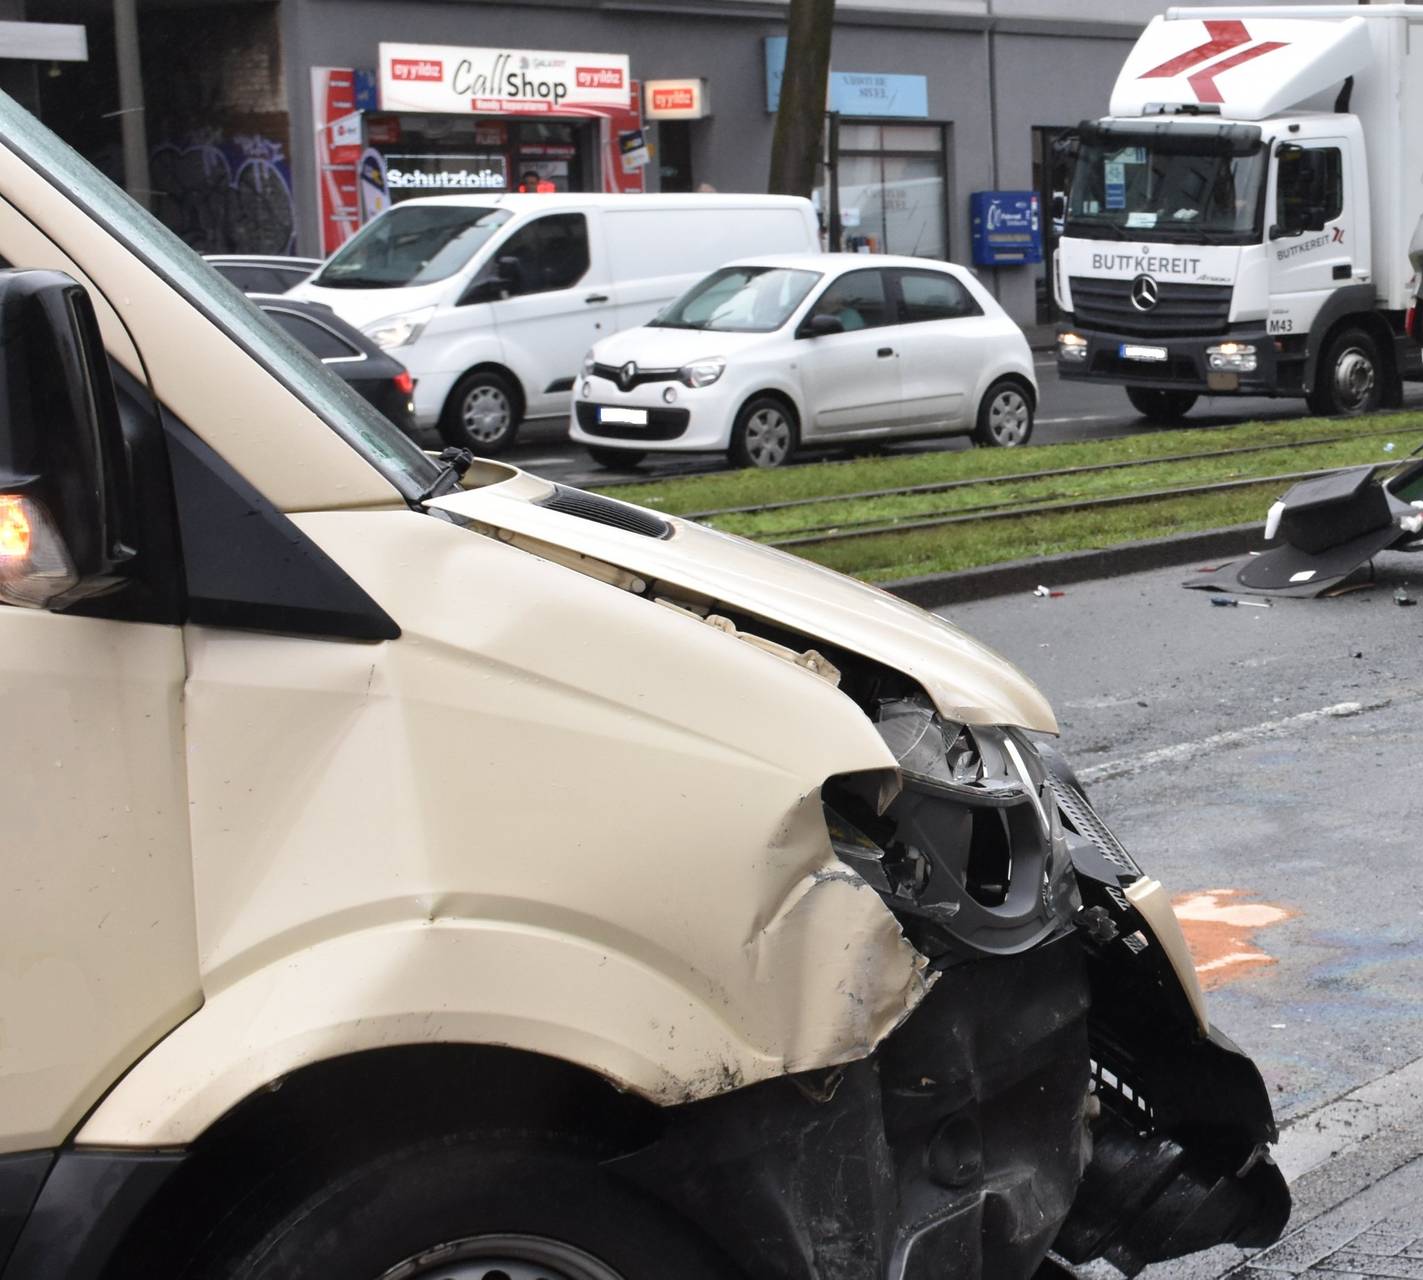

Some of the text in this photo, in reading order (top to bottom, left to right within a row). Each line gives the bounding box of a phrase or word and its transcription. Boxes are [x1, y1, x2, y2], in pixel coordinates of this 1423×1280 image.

[386, 169, 504, 188] Schutzfolie
[1277, 234, 1330, 260] BUTTKEREIT
[1092, 253, 1201, 275] BUTTKEREIT
[1269, 319, 1293, 332] M43
